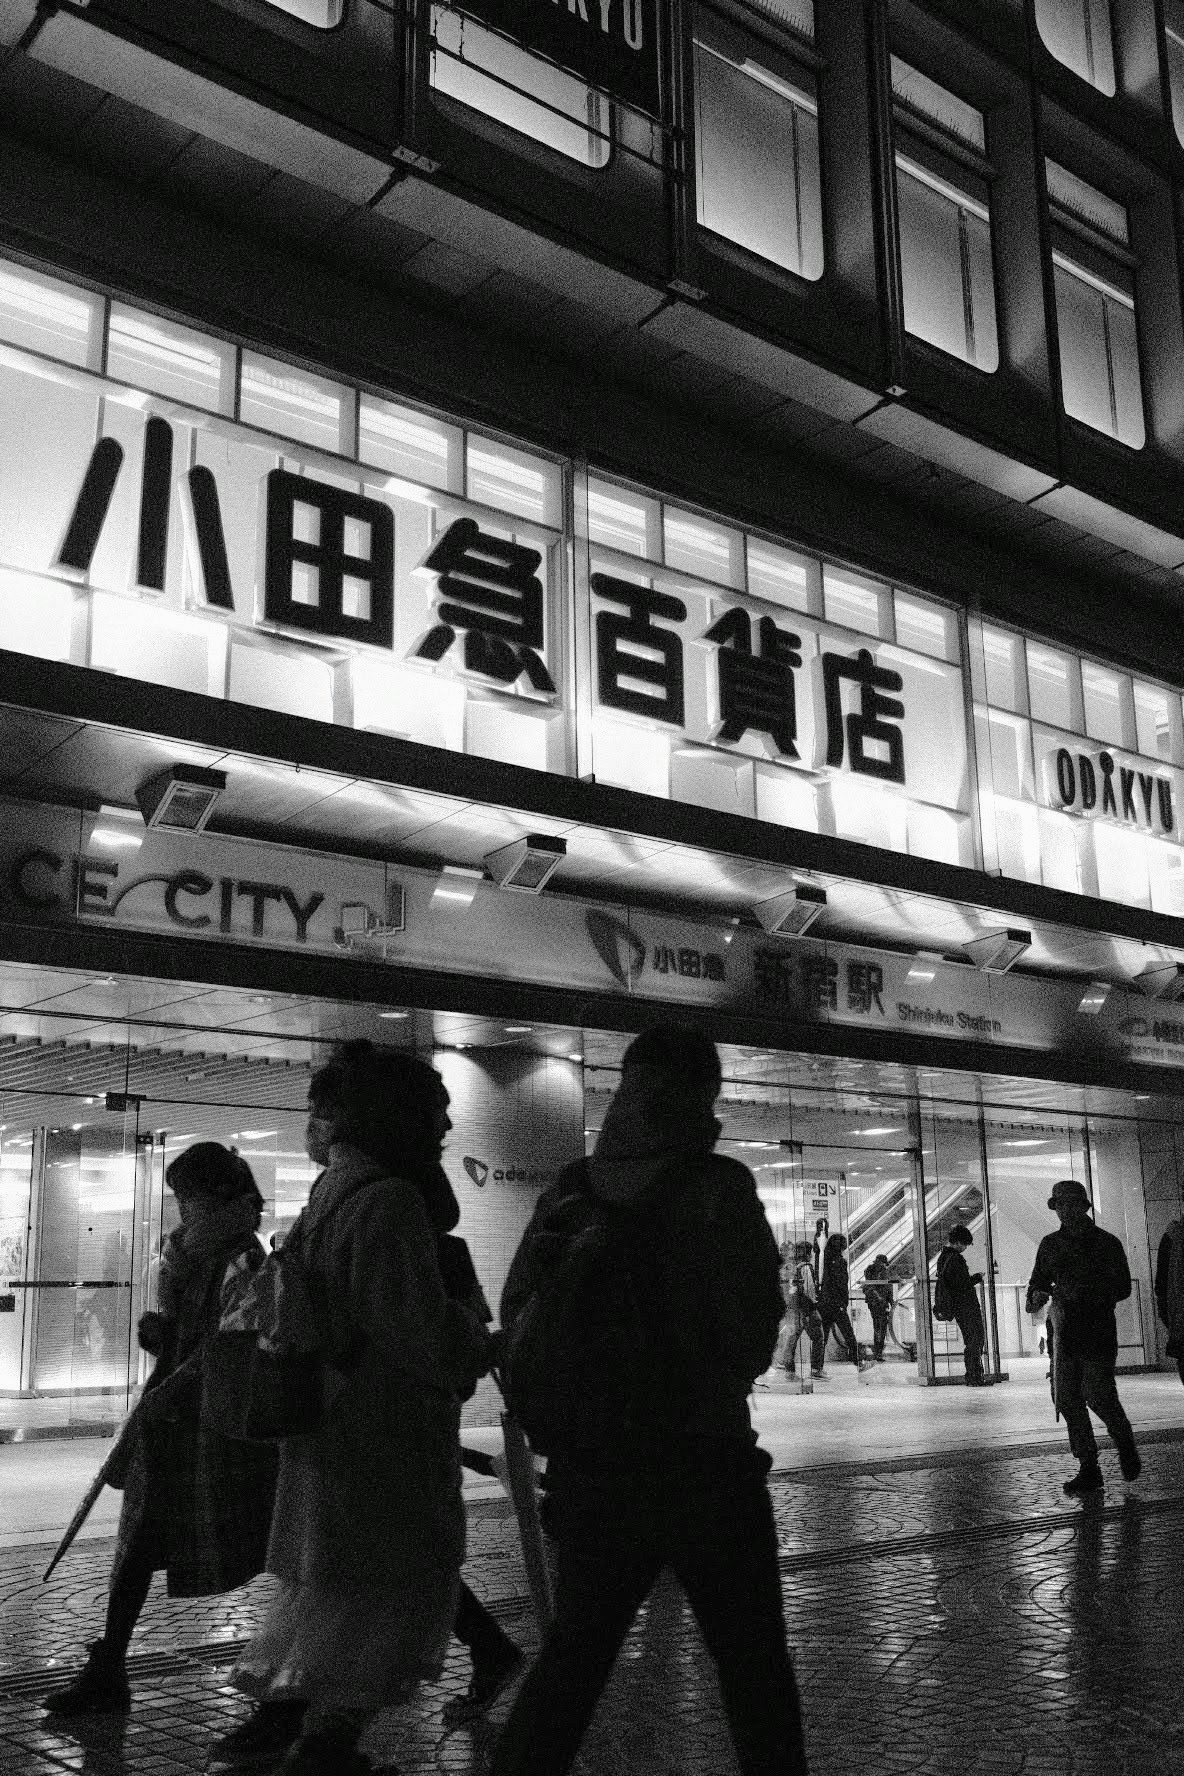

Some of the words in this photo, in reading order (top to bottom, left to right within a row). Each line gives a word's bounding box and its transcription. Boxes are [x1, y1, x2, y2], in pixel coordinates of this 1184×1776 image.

[58, 416, 906, 784] 小田急百貨店
[1057, 746, 1173, 832] ODAKYU
[164, 867, 326, 943] CITY
[654, 945, 725, 982] 小田急
[896, 1001, 953, 1027] Shinjuku
[957, 1010, 1002, 1032] Station
